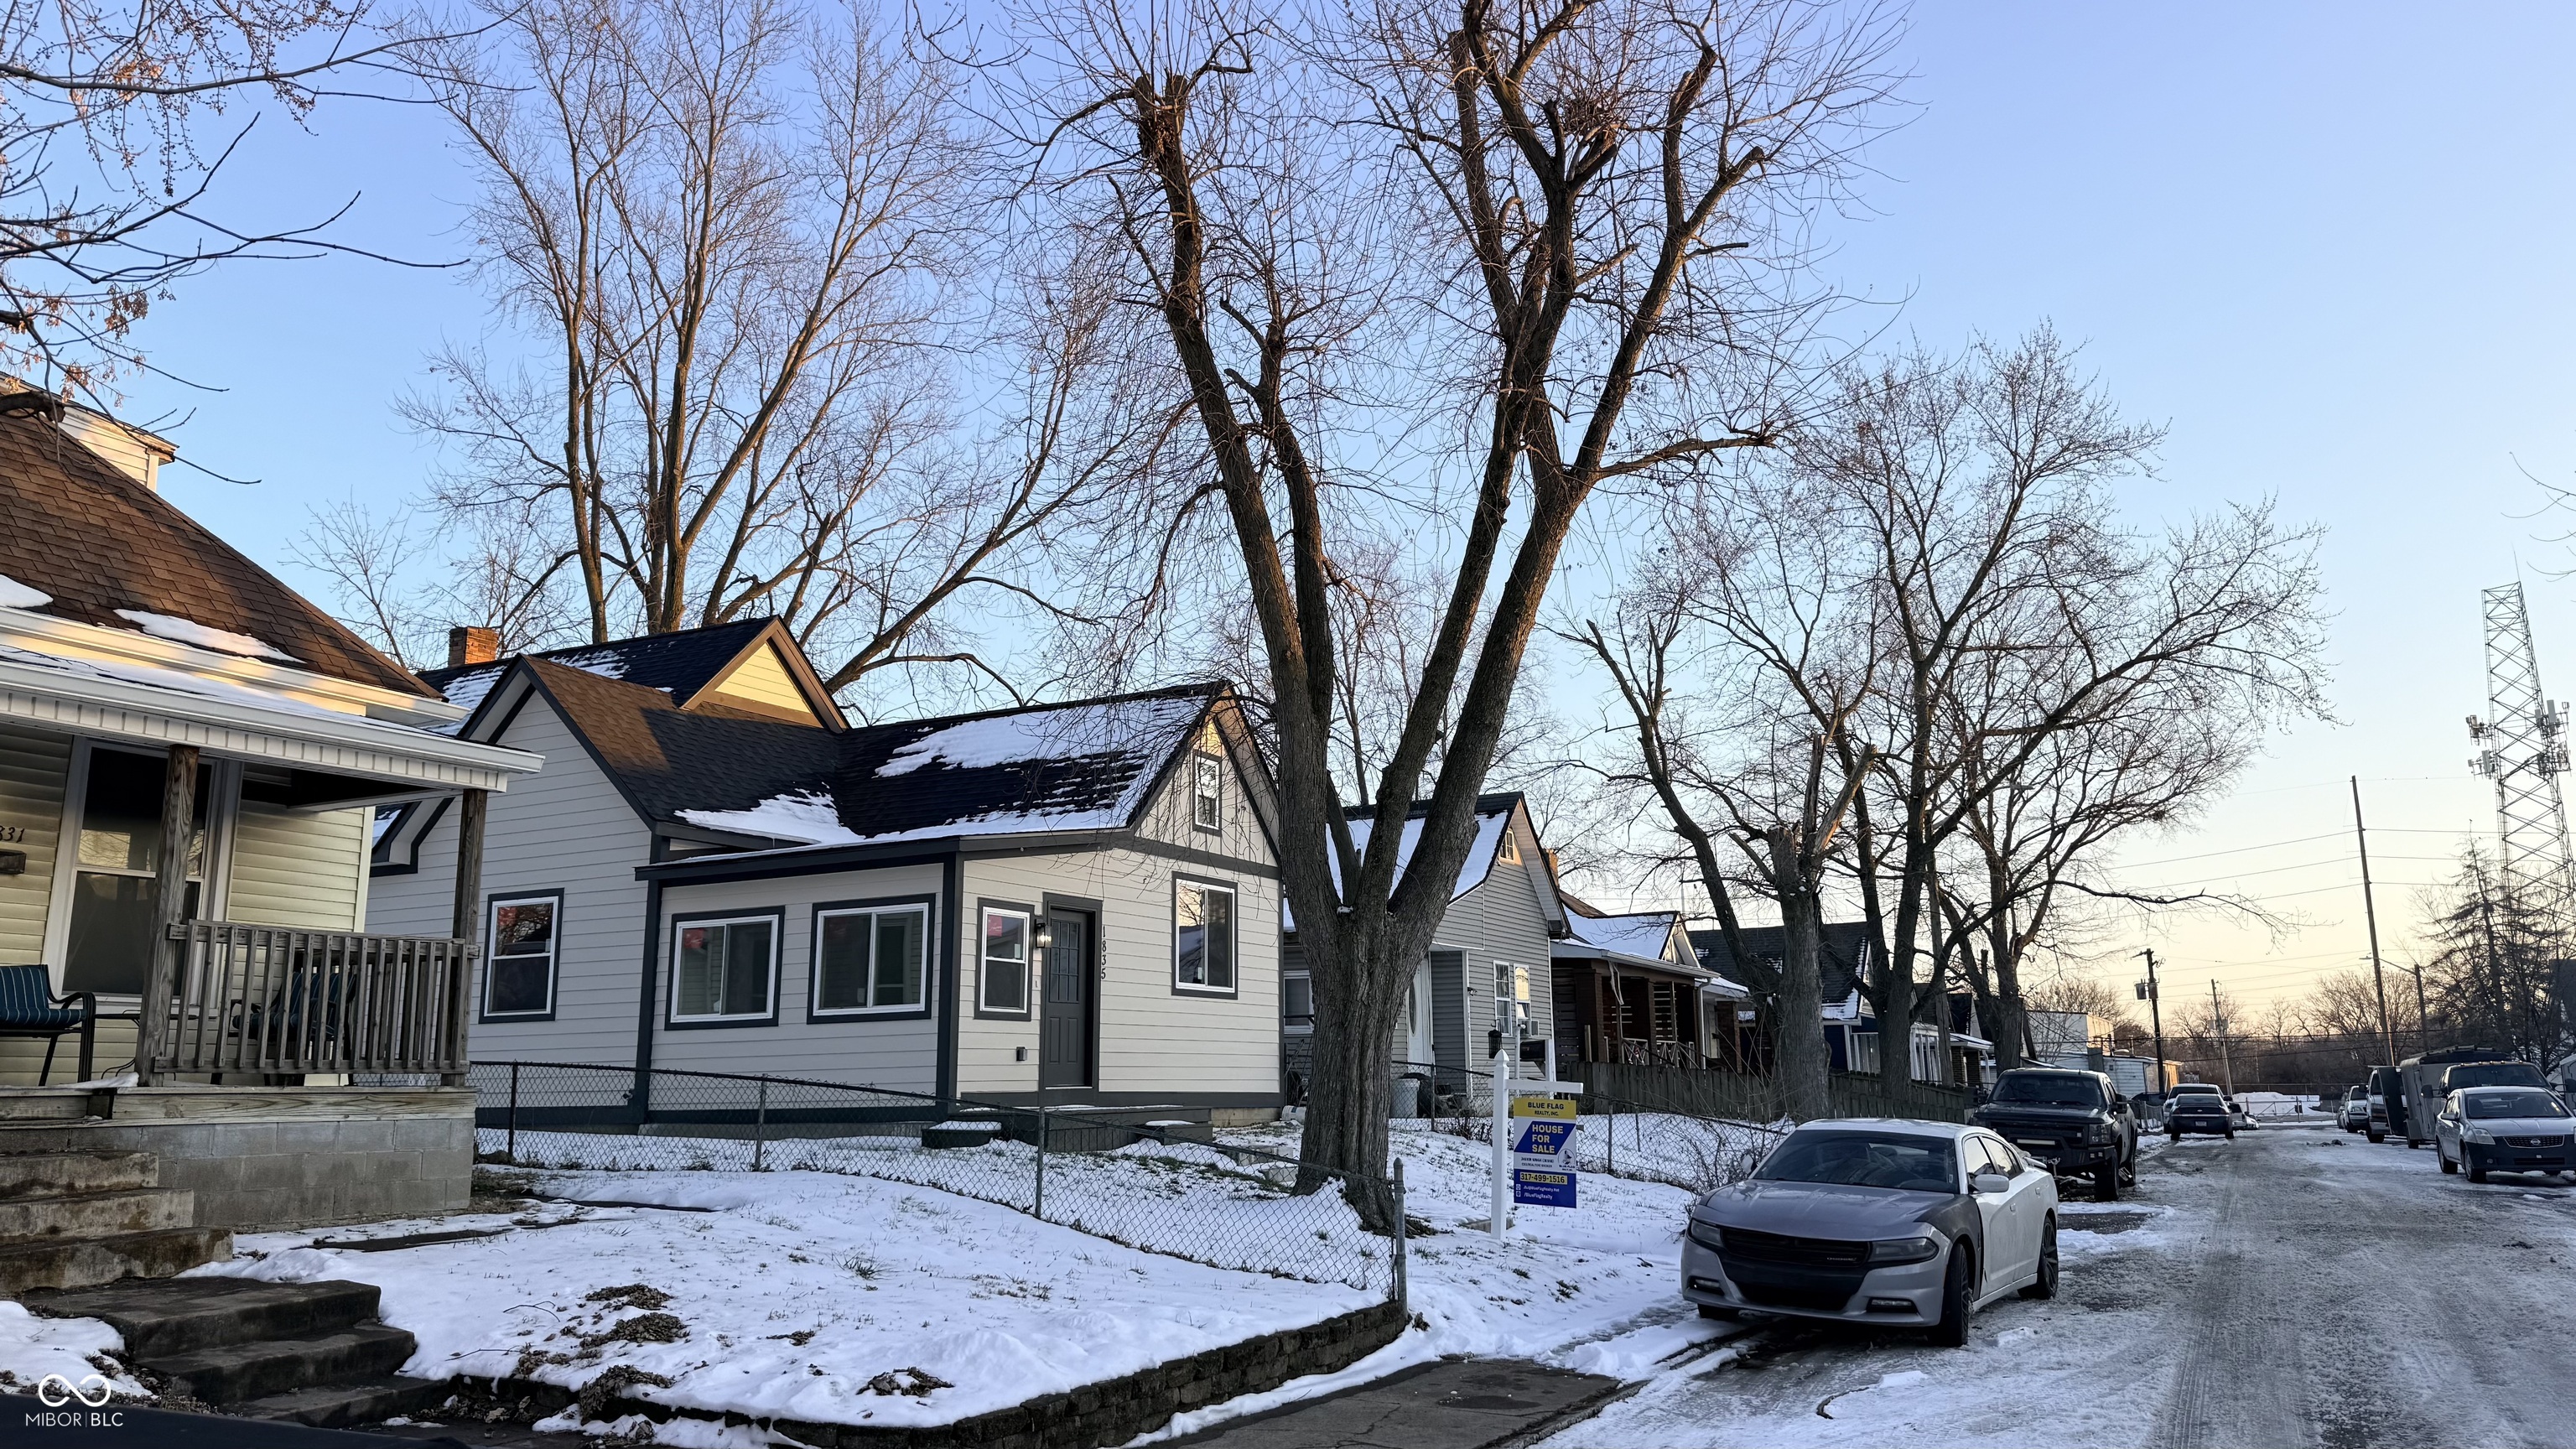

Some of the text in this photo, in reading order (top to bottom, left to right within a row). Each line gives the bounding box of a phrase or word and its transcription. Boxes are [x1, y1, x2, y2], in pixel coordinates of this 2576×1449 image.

[1532, 1124, 1564, 1134] HOUSE
[1532, 1135, 1550, 1143] FOR
[1532, 1145, 1555, 1154] SALE
[1520, 1173, 1566, 1183] 317-499-1516
